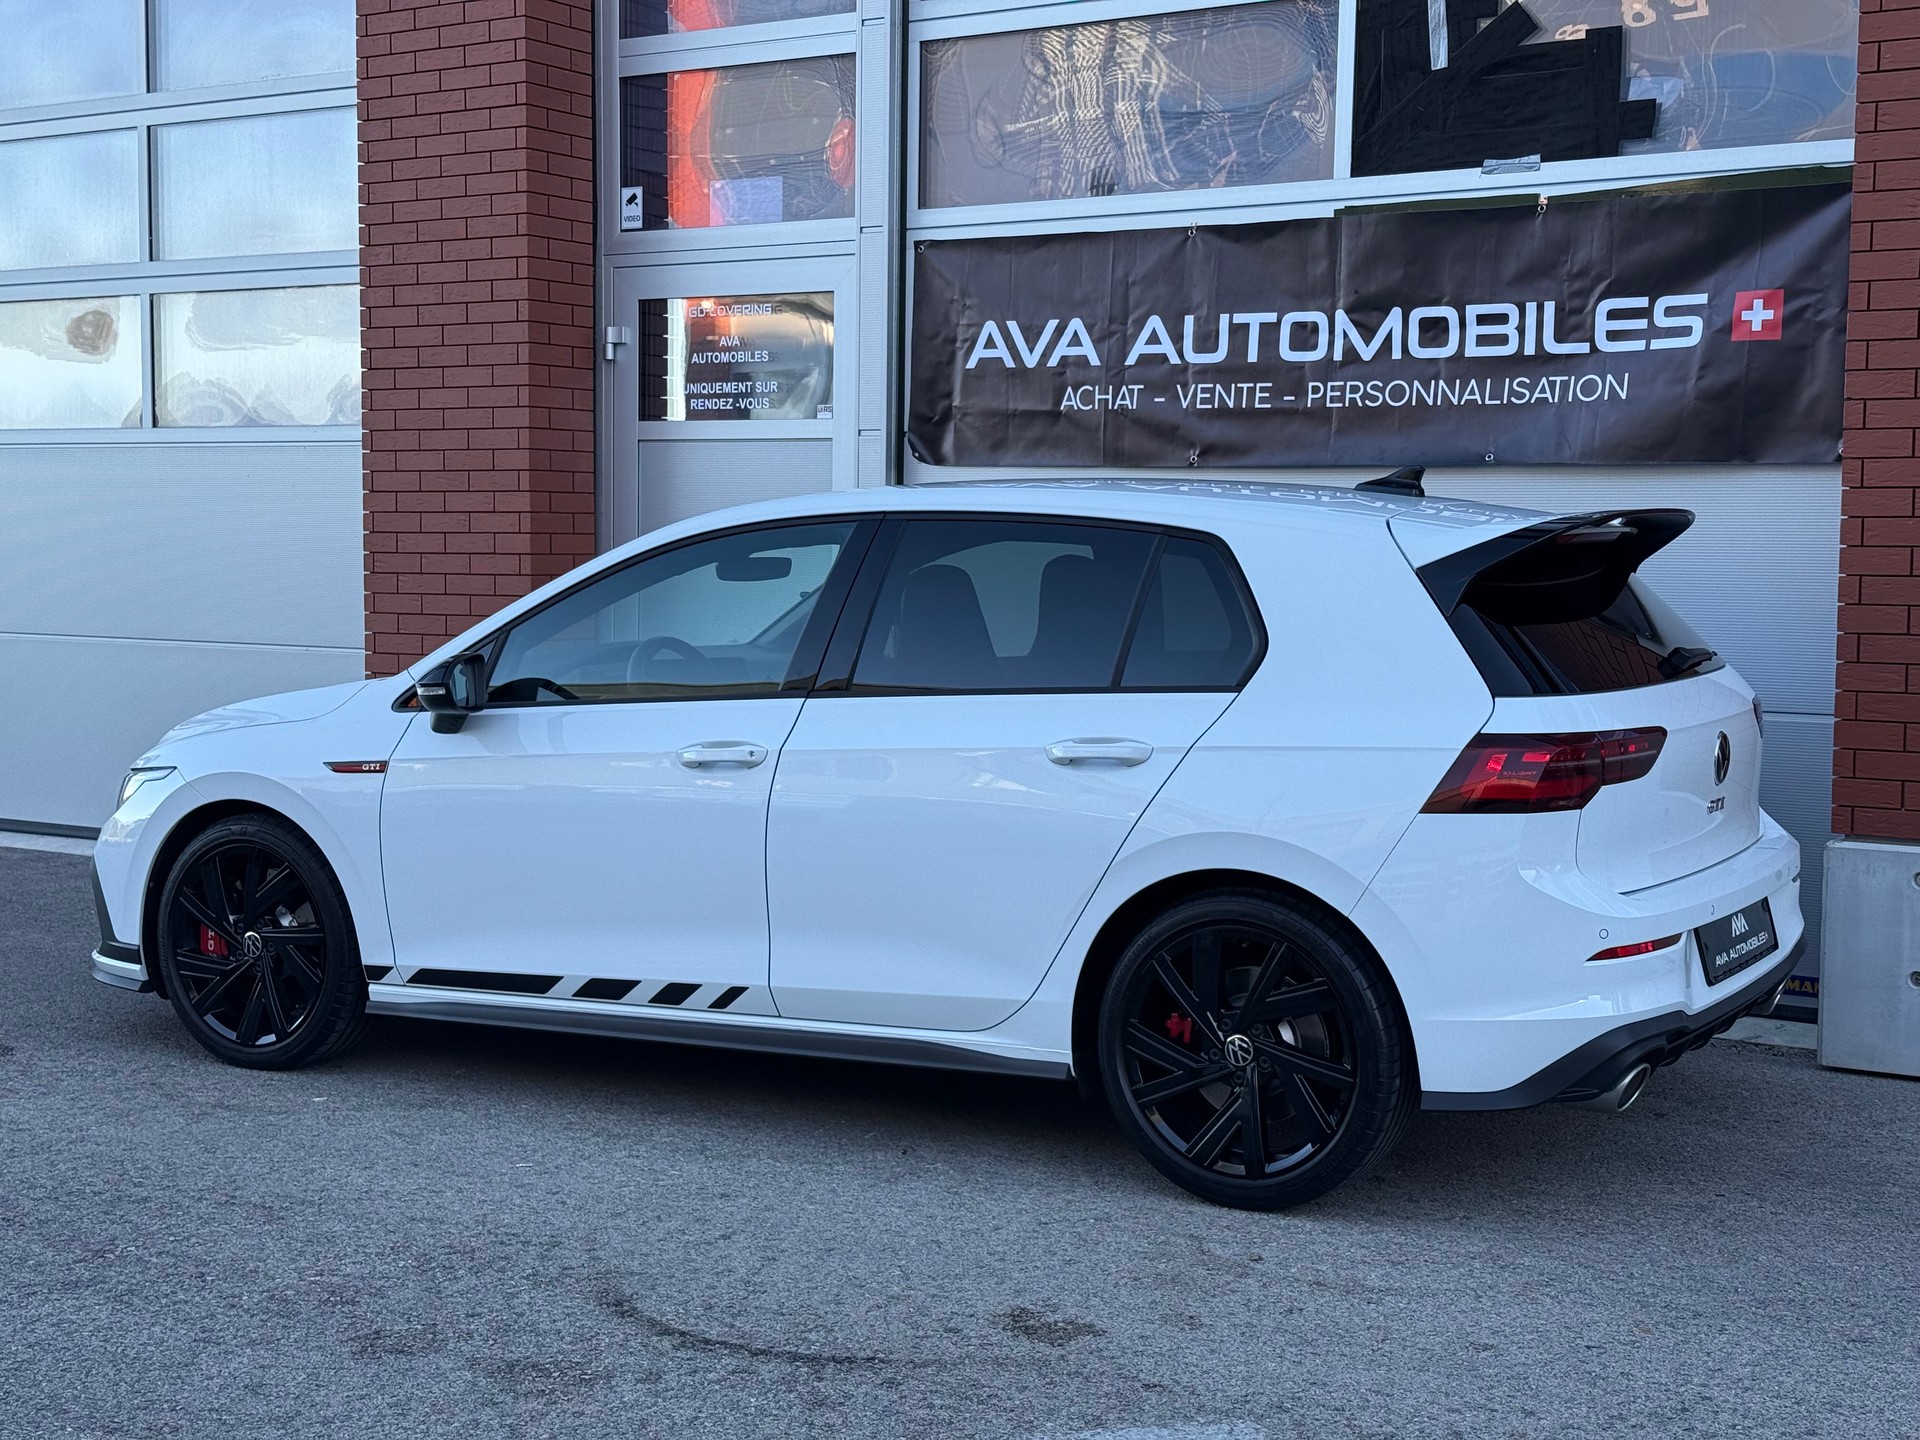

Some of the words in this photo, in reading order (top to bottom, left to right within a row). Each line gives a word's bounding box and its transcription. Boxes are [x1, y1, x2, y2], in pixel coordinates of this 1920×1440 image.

[965, 317, 1101, 369] AVA
[1124, 292, 1709, 366] AUTOMOBILES
[719, 336, 741, 347] AVA
[691, 350, 769, 364] AUTOMOBILES
[755, 381, 778, 393] SUR
[1060, 384, 1145, 411] ACHAT
[1176, 382, 1273, 410] VENTE
[1306, 372, 1630, 409] PERSONNALISATION
[690, 398, 734, 410] RENDEZ
[362, 763, 381, 771] GTI
[1706, 796, 1726, 815] GTI
[1715, 951, 1730, 968] AVA
[1729, 931, 1766, 961] AUTOMOBILES
